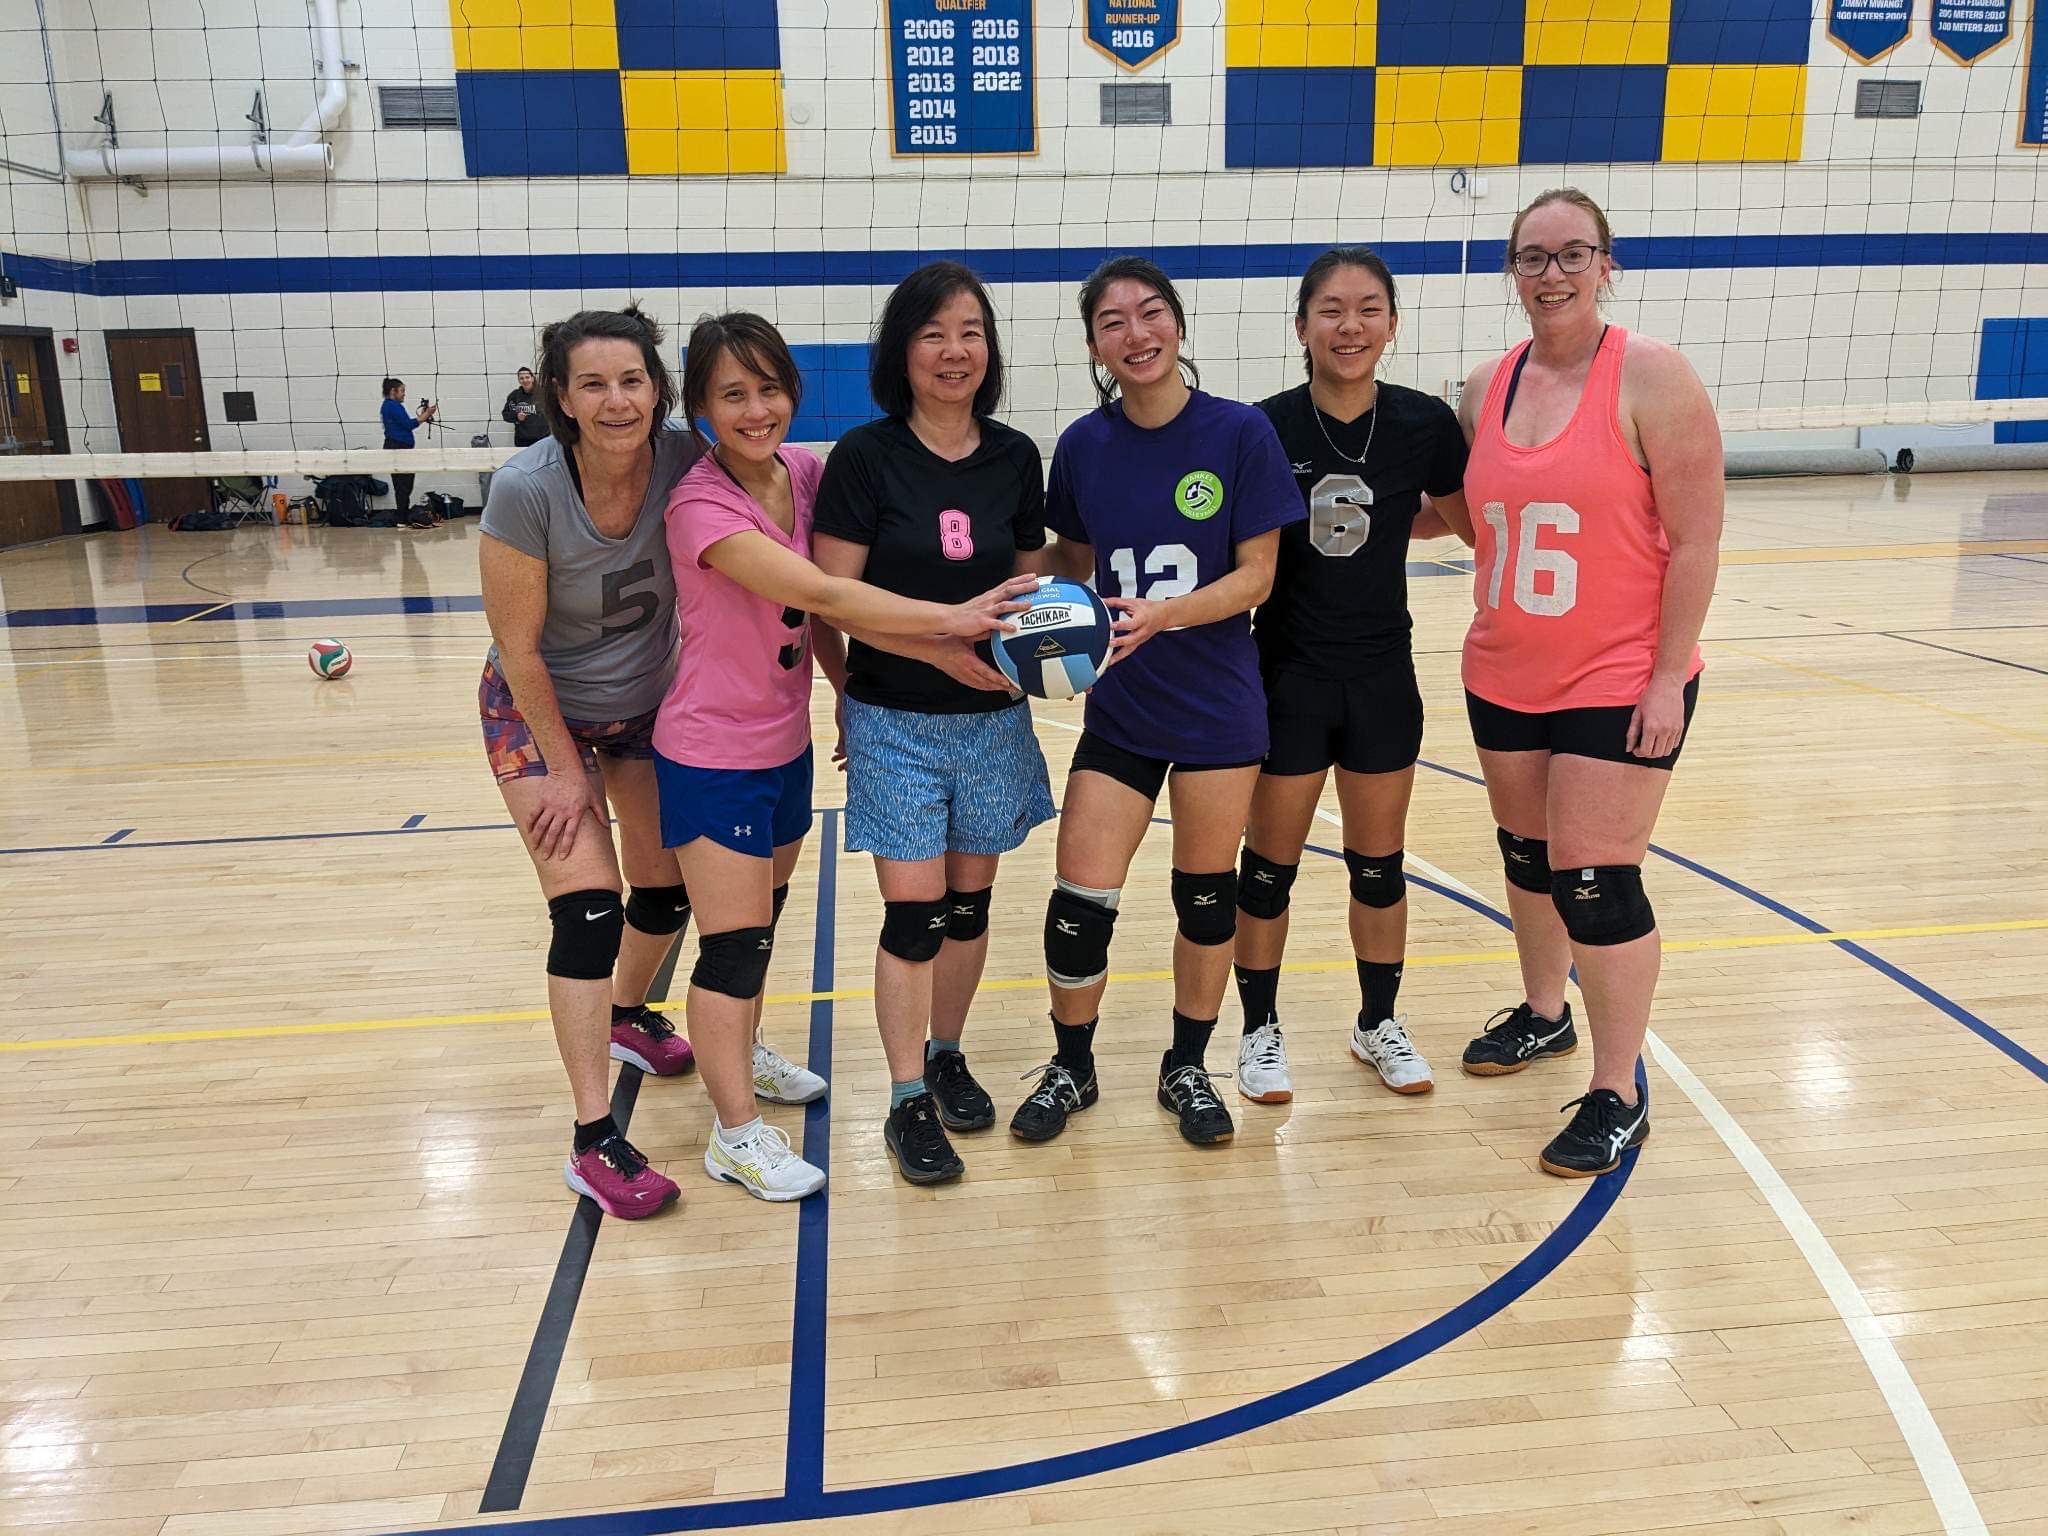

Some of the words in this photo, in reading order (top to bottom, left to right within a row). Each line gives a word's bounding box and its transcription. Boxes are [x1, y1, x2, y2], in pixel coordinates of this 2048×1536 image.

[1109, 0, 1156, 8] NATIONAL
[1105, 13, 1160, 24] RUNNER-UP
[1853, 11, 1884, 20] METERS
[1953, 10, 1984, 19] METERS
[1984, 11, 2006, 20] 2010
[903, 19, 955, 39] 2006
[971, 19, 1019, 39] 2016
[1937, 21, 1952, 31] 100
[1952, 22, 1983, 32] METERS
[1111, 30, 1154, 48] 2016
[907, 46, 954, 67] 2012
[971, 46, 1020, 66] 2018
[908, 73, 955, 93] 2013
[973, 71, 1022, 92] 2022
[909, 99, 956, 119] 2014
[910, 125, 957, 145] 2015
[1309, 473, 1374, 557] 6
[939, 509, 973, 560] 8
[1482, 501, 1580, 617] 16
[1109, 543, 1198, 630] 12
[601, 558, 659, 637] 5
[1018, 609, 1070, 626] TACHIKARA
